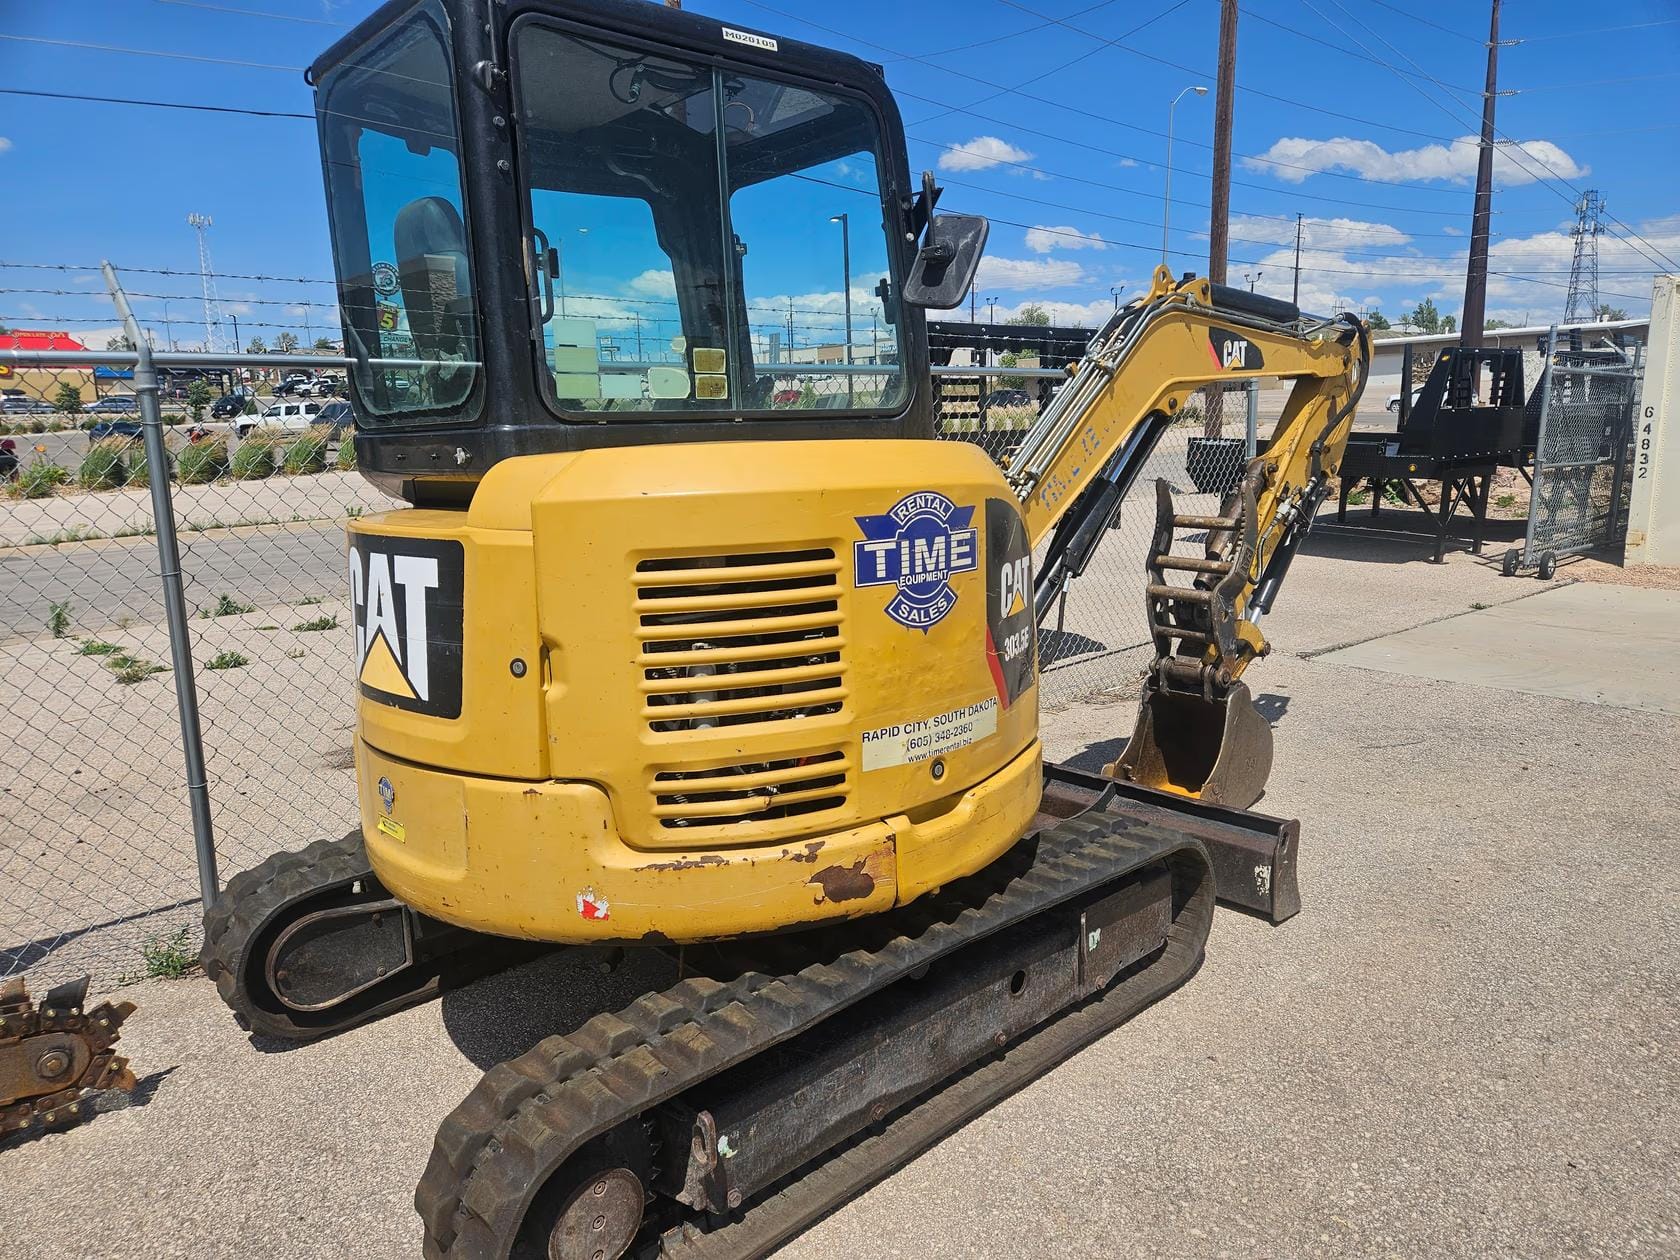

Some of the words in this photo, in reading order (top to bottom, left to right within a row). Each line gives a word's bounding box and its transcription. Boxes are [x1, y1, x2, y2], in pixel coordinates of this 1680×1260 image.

[380, 312, 394, 329] 5
[1223, 339, 1248, 368] CAT
[1638, 406, 1655, 479] 64832
[897, 495, 948, 520] RENTAL
[864, 532, 972, 578] TIME
[900, 569, 948, 587] EQUIPMENT
[1000, 555, 1030, 619] CAT
[349, 546, 439, 702] CAT
[899, 597, 948, 622] SALES
[1004, 625, 1029, 662] 303.5E
[862, 725, 900, 743] RAPID
[933, 708, 966, 727] SOUTH
[968, 696, 998, 717] DAKOTA
[906, 734, 932, 752] (605)
[934, 721, 973, 743] 348-2360
